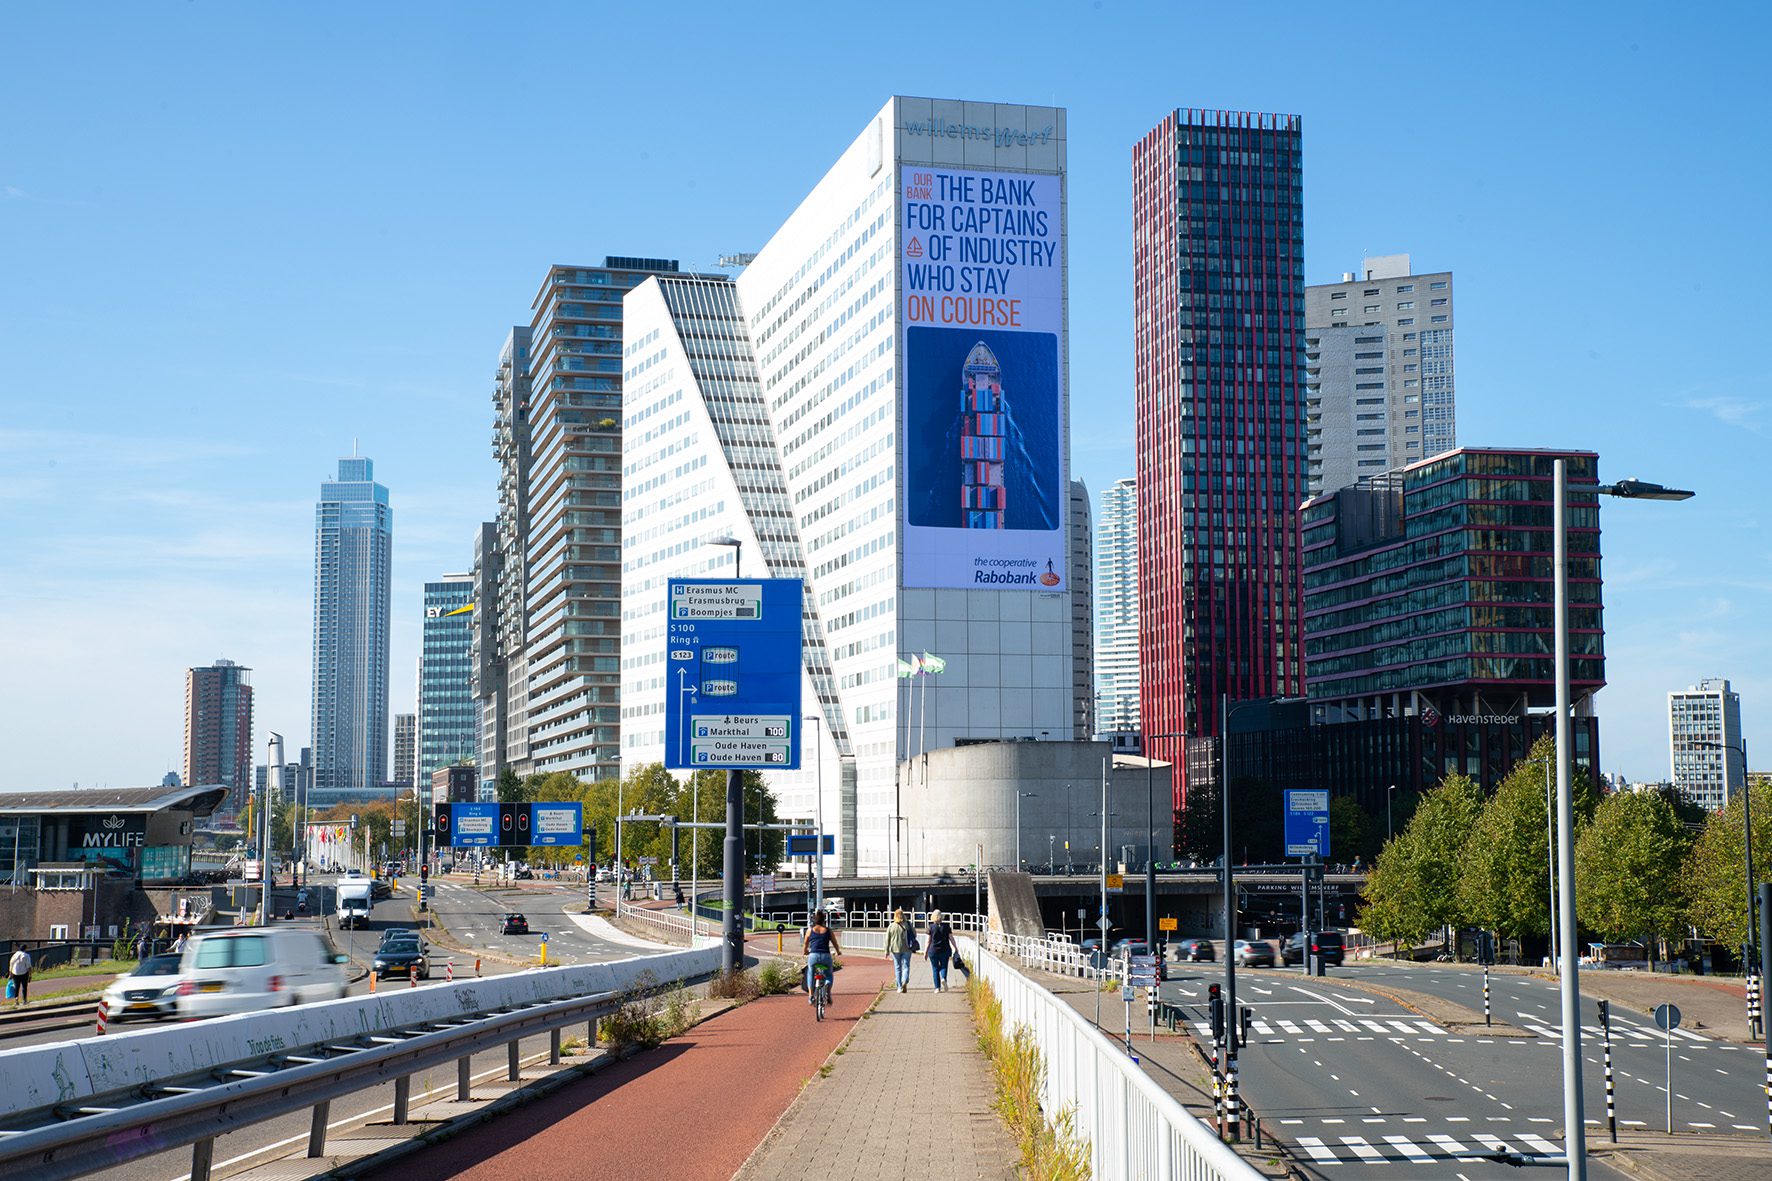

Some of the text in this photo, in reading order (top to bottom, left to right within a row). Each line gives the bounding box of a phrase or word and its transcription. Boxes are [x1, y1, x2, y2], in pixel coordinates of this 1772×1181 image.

[914, 172, 932, 186] OUR
[906, 186, 932, 200] BANK
[936, 174, 1036, 206] THE BANK
[907, 202, 1048, 236] FOR CAPTAINS
[929, 234, 1056, 267] OF INDUSTRY
[908, 264, 1010, 294] WHO STAY
[908, 294, 1021, 326] ON COURSE
[974, 557, 1038, 568] the cooperative
[974, 570, 1037, 584] Rabobank
[688, 597, 745, 606] Erasmusbrug
[426, 606, 442, 618] EY
[690, 608, 732, 617] Boompjes
[670, 636, 690, 645] Ring
[772, 754, 784, 762] 80
